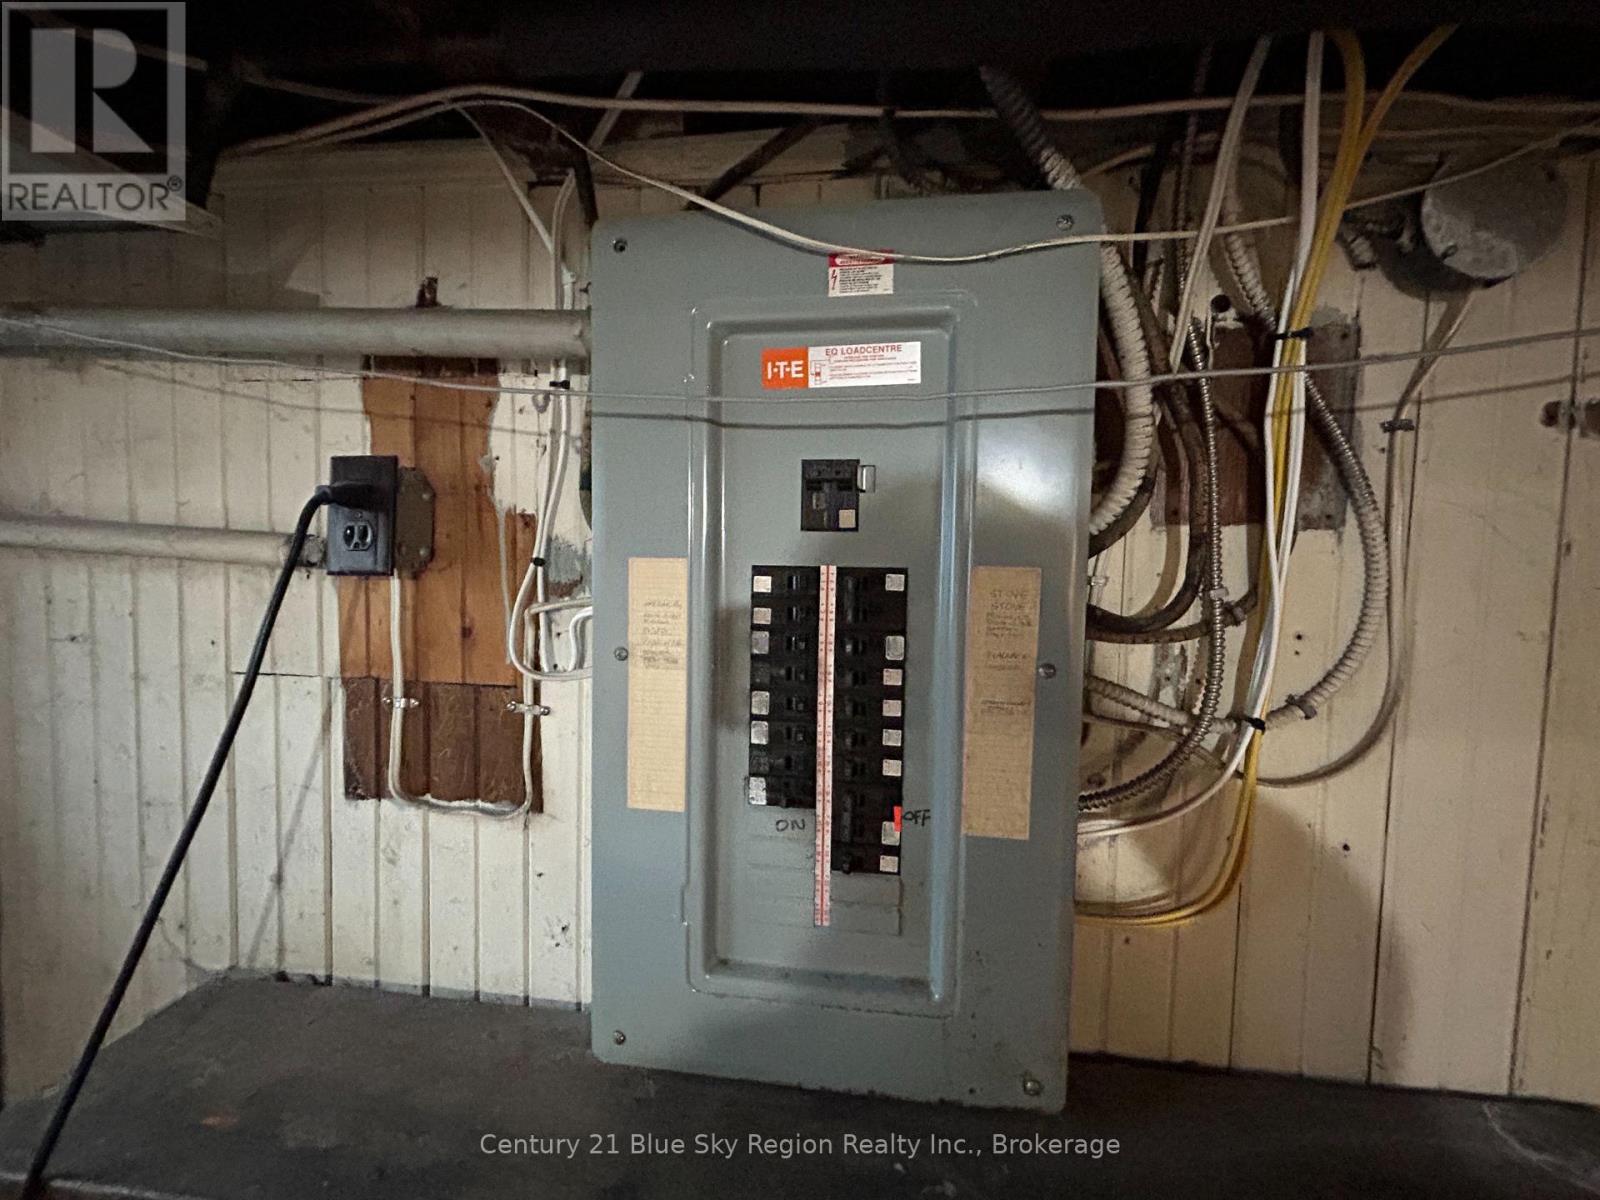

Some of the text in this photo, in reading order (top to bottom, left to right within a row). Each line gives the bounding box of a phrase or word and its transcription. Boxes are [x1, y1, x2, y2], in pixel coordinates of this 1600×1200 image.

[841, 344, 903, 355] LOADCENTRE
[775, 818, 806, 832] ON
[903, 809, 931, 827] OFF
